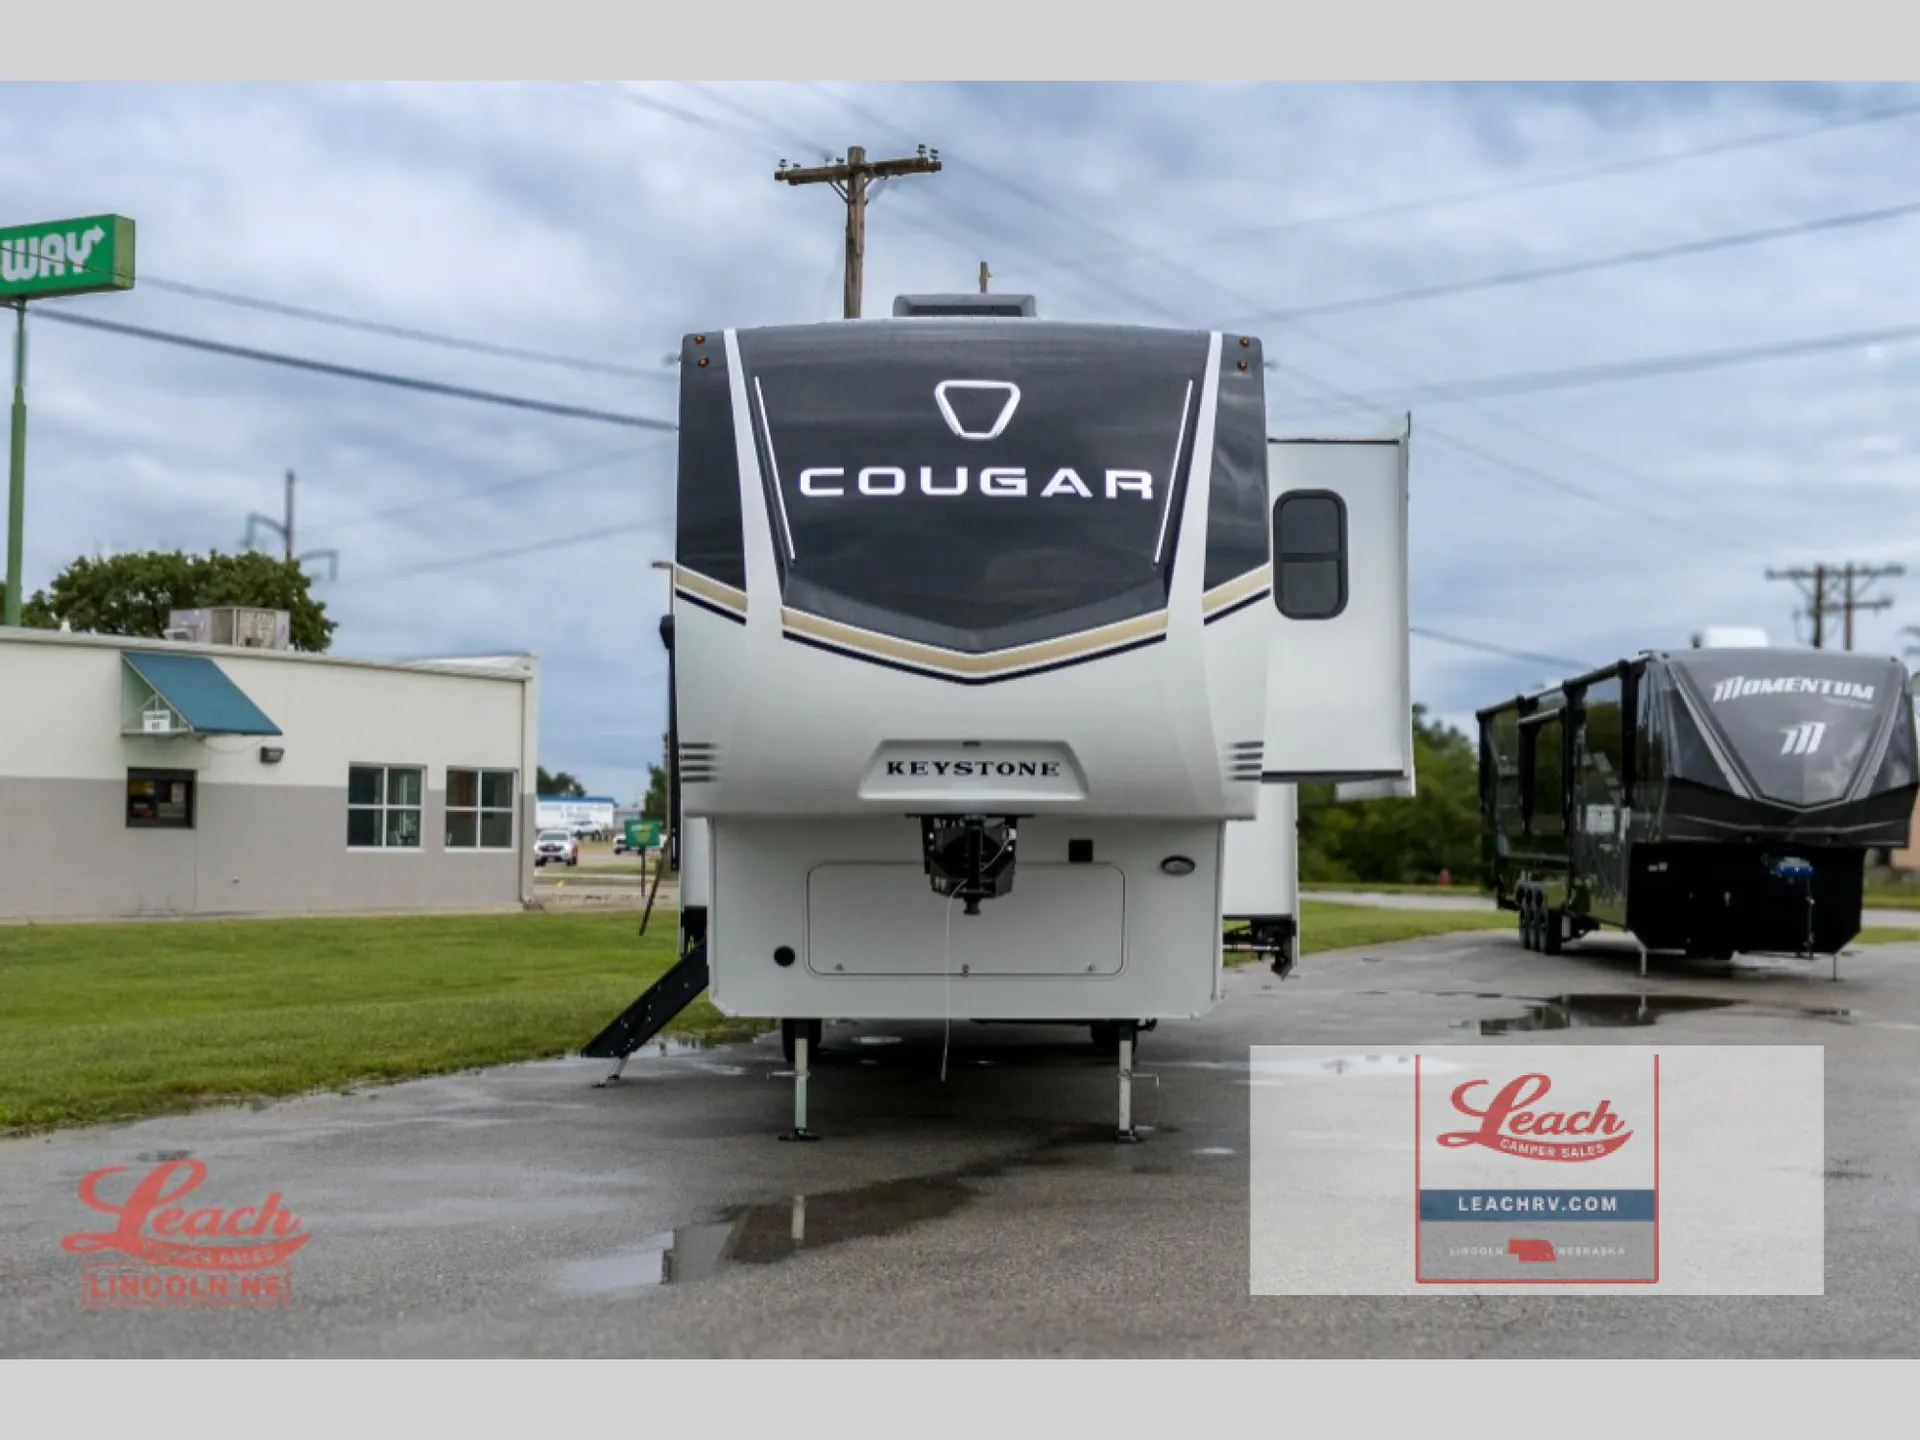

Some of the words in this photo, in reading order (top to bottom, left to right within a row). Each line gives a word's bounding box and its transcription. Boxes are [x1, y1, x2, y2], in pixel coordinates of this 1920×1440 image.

[799, 466, 1154, 500] COUGAR
[1712, 676, 1875, 703] MOMENTUM
[886, 760, 1060, 777] KEYSTONE
